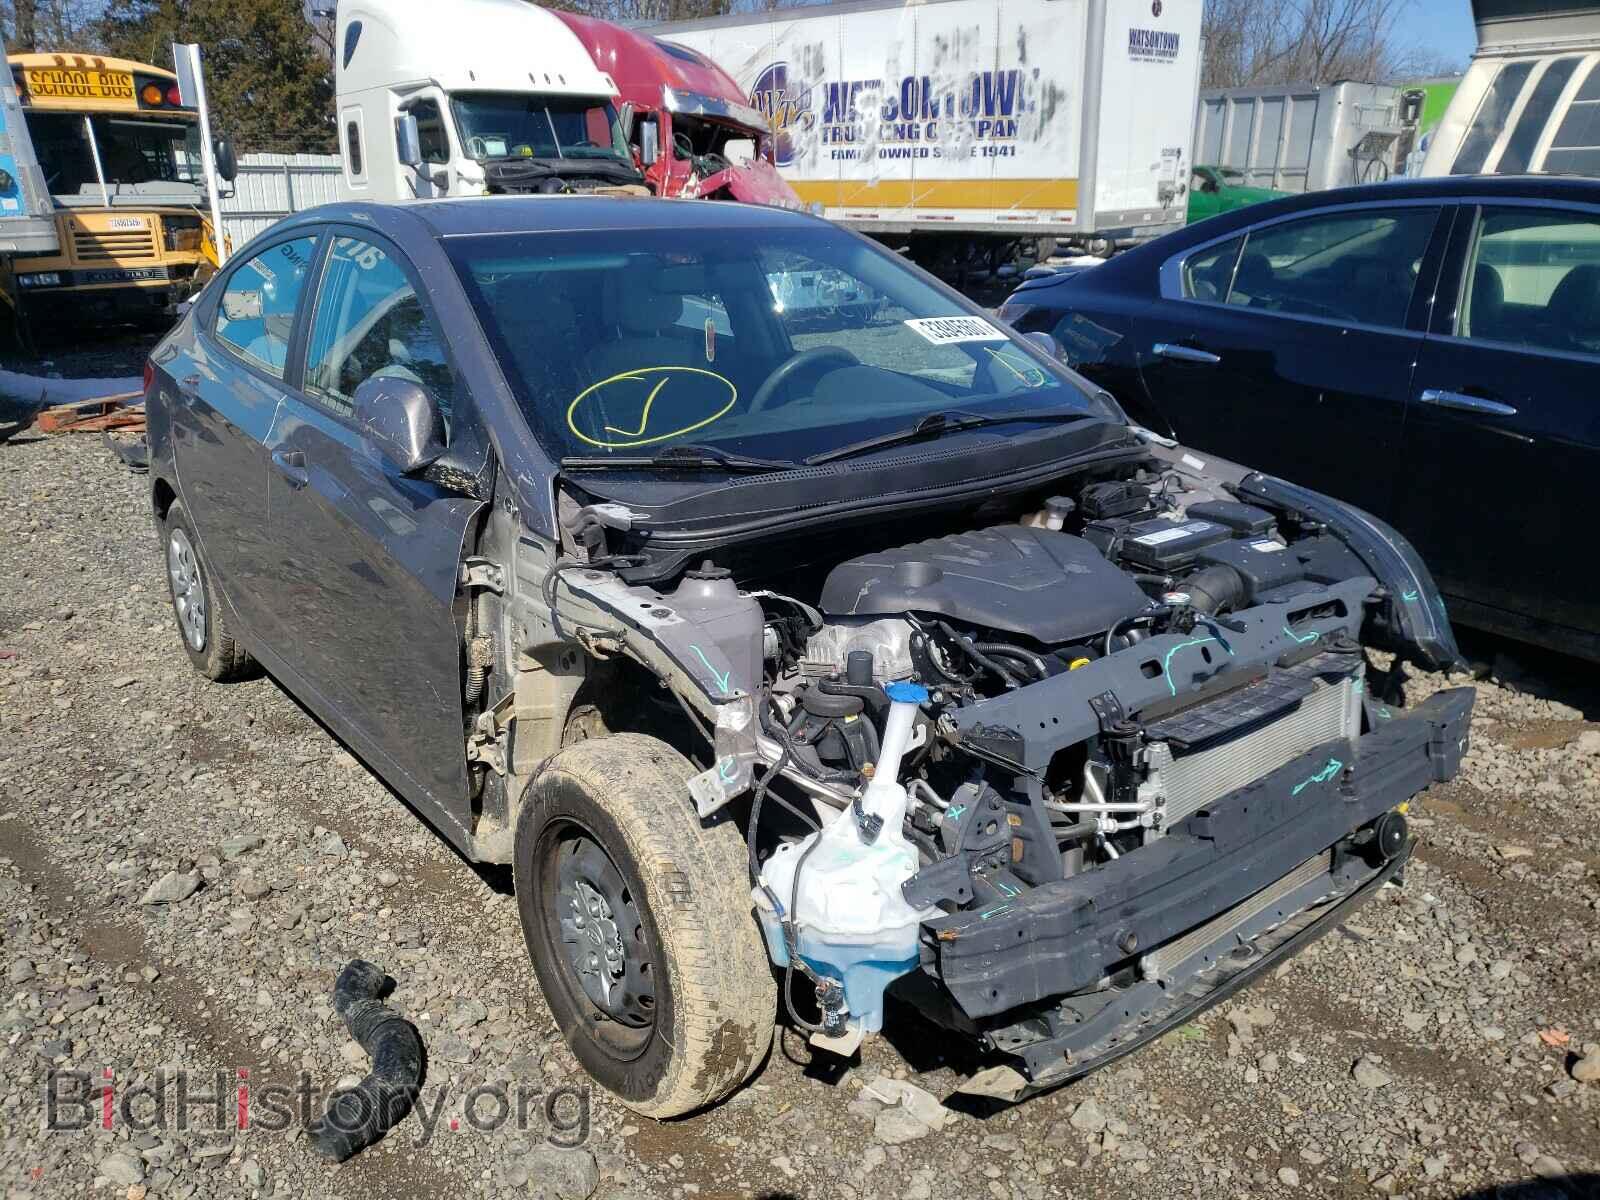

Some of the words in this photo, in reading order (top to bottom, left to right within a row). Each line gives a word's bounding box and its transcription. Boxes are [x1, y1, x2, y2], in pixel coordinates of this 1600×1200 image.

[1129, 28, 1180, 50] WATSONTOWN
[31, 71, 97, 96] SCHOOL
[99, 73, 132, 97] BUS
[879, 147, 929, 159] OWNED
[982, 145, 1016, 157] 1941
